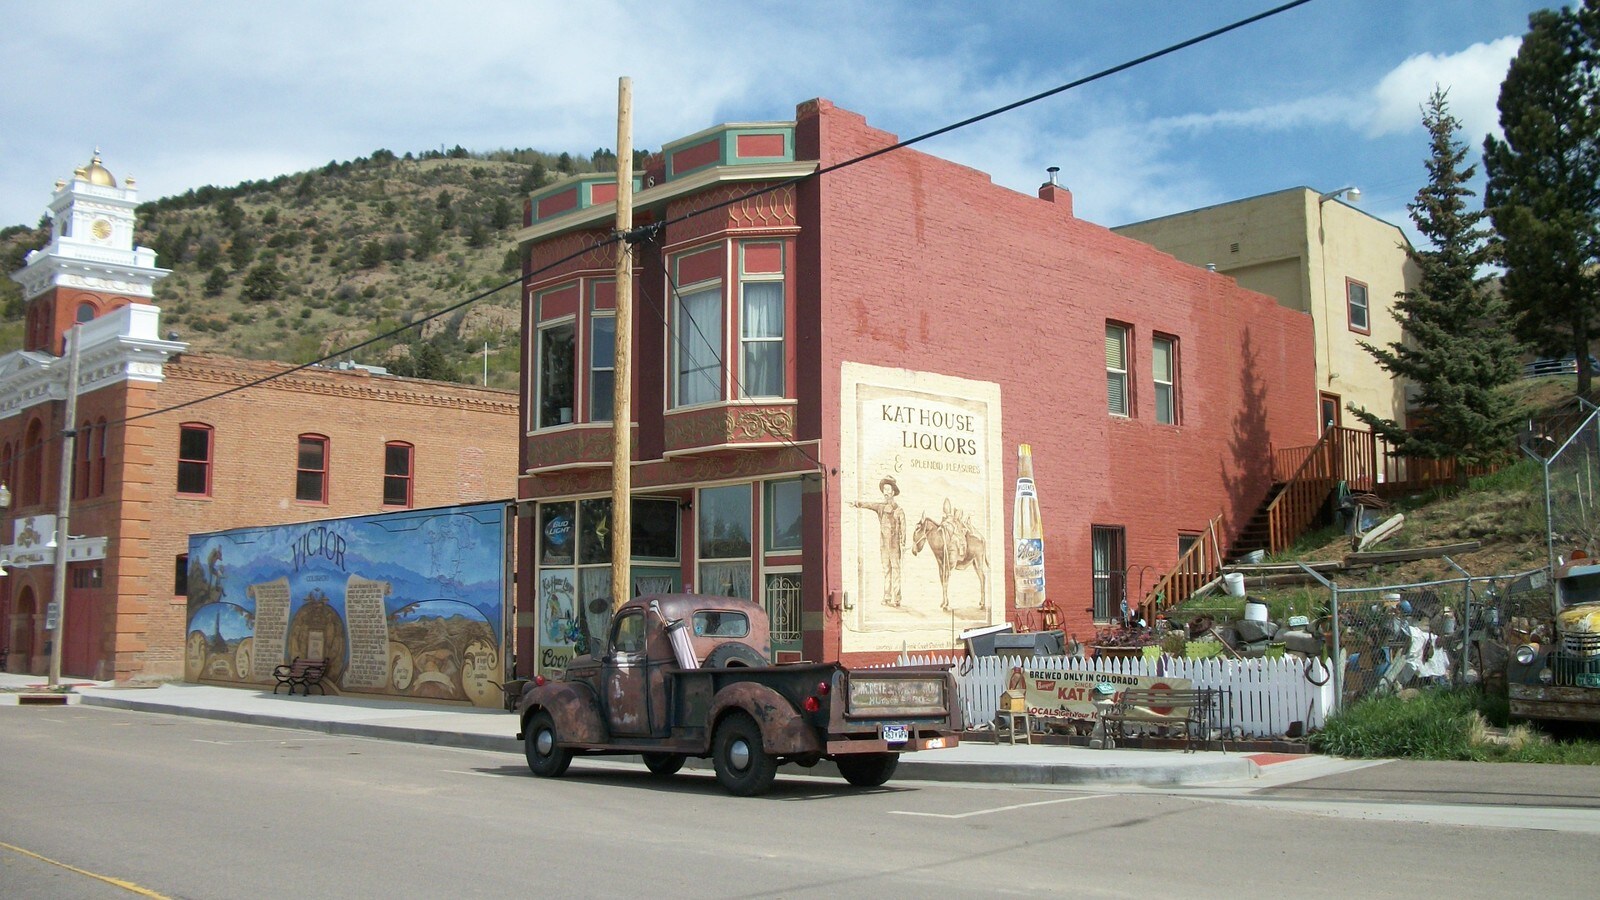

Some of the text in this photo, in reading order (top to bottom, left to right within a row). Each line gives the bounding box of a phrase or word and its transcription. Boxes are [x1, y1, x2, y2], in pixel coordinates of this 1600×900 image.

[882, 405, 975, 432] KAT HOUSE
[902, 431, 976, 455] LIQUORS
[894, 454, 903, 473] &
[910, 459, 943, 470] SPLENDID
[549, 527, 571, 535] LIGHT
[292, 527, 346, 572] VICTOR
[1030, 671, 1139, 685] BREWED ONLY IN COLORADO
[1058, 687, 1085, 701] KAT
[1074, 711, 1089, 719] Your
